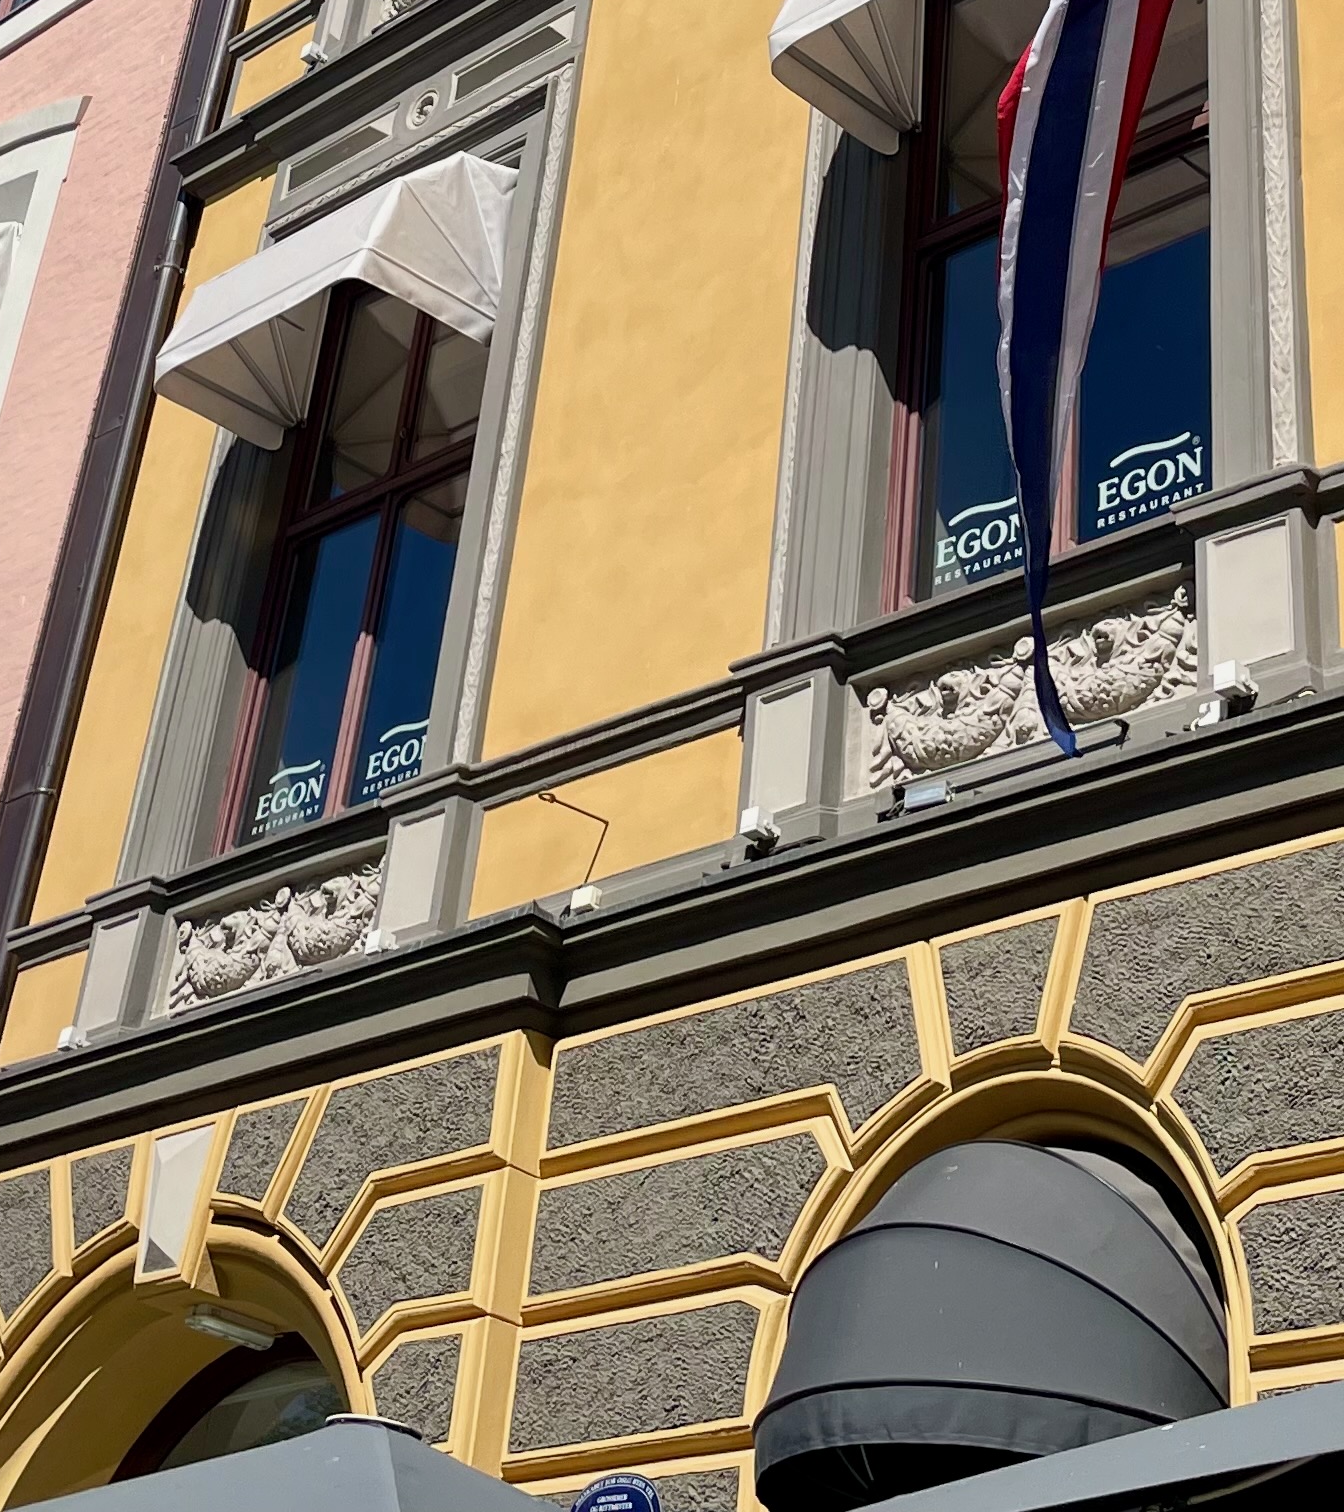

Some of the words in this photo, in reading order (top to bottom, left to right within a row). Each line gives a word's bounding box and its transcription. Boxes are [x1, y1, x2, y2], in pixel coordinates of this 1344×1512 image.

[1097, 447, 1203, 512] EGON
[1096, 483, 1204, 529] RESTAURANT
[934, 547, 1023, 585] RESTAURAN
[255, 774, 325, 821] EGON
[362, 768, 419, 795] RESTAURA
[251, 804, 320, 836] RESTAURANT
